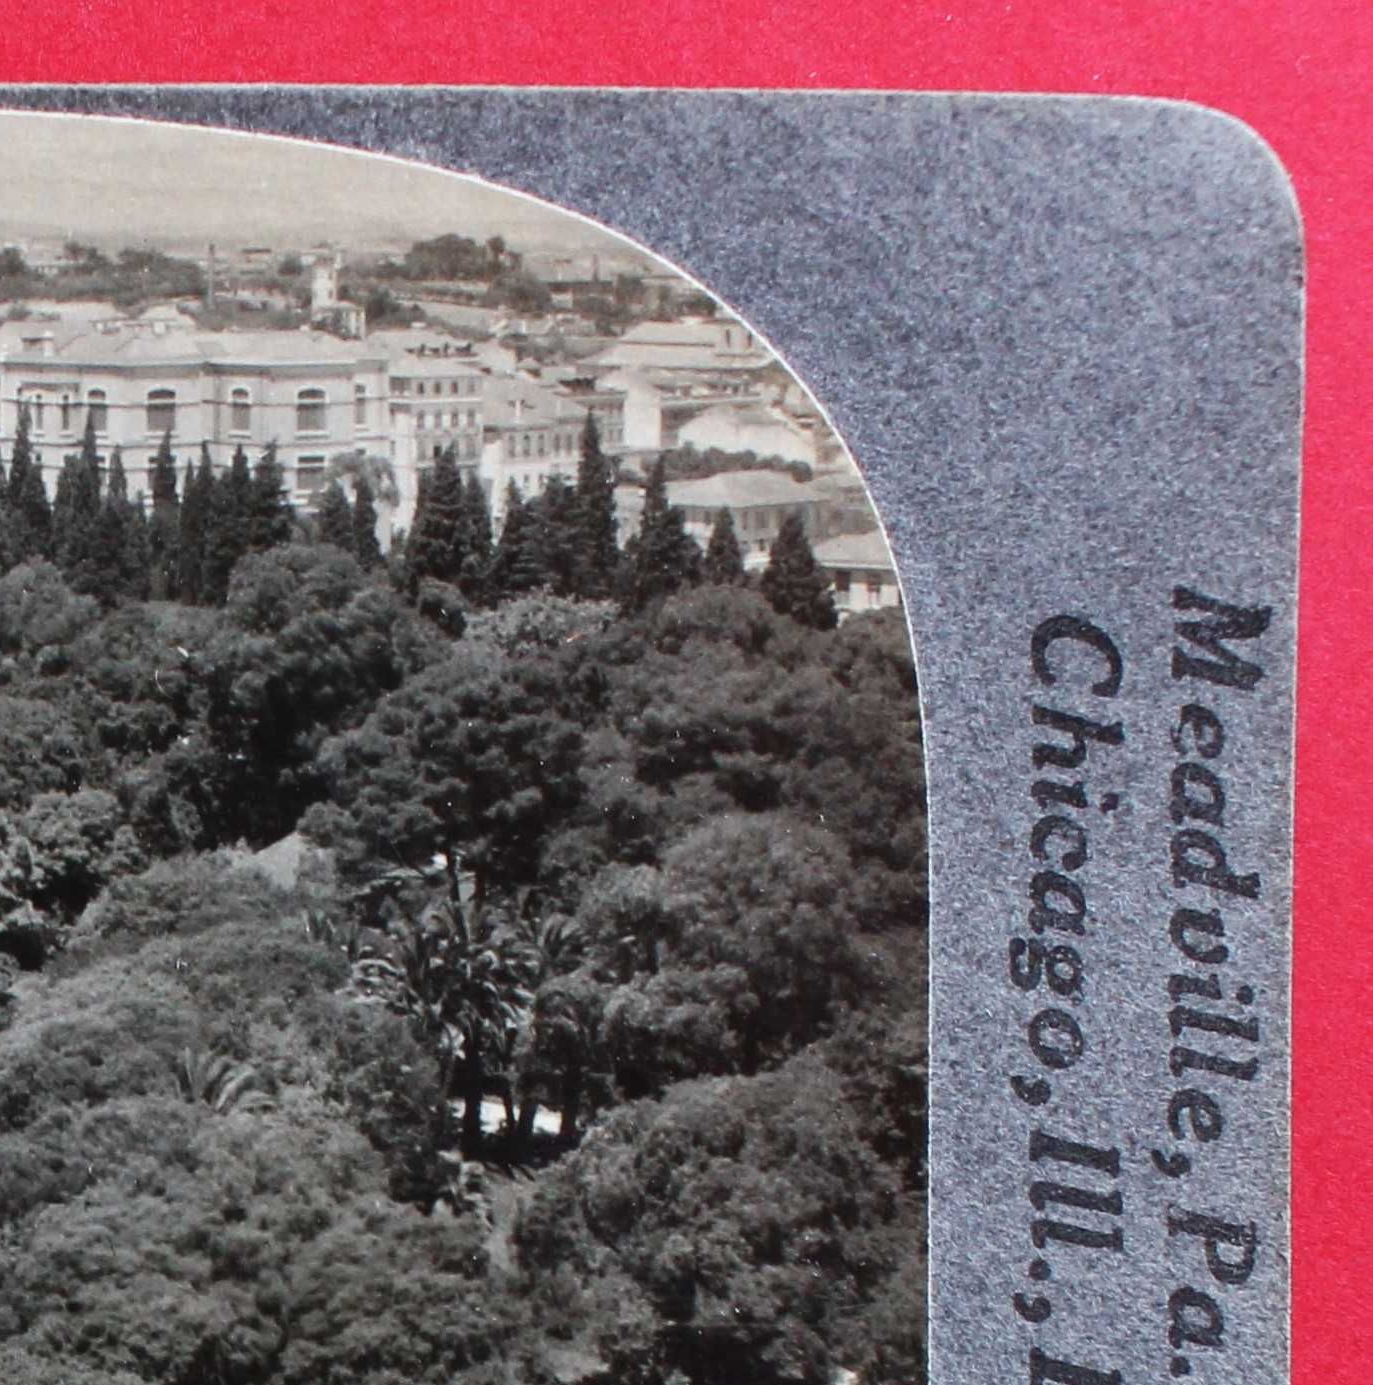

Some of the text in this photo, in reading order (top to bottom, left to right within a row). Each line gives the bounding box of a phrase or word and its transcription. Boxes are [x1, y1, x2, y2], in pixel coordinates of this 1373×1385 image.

[1010, 615, 1124, 1104] Chicago,
[1153, 588, 1270, 1177] Meadville,
[1014, 1132, 1122, 1322] Ill.,
